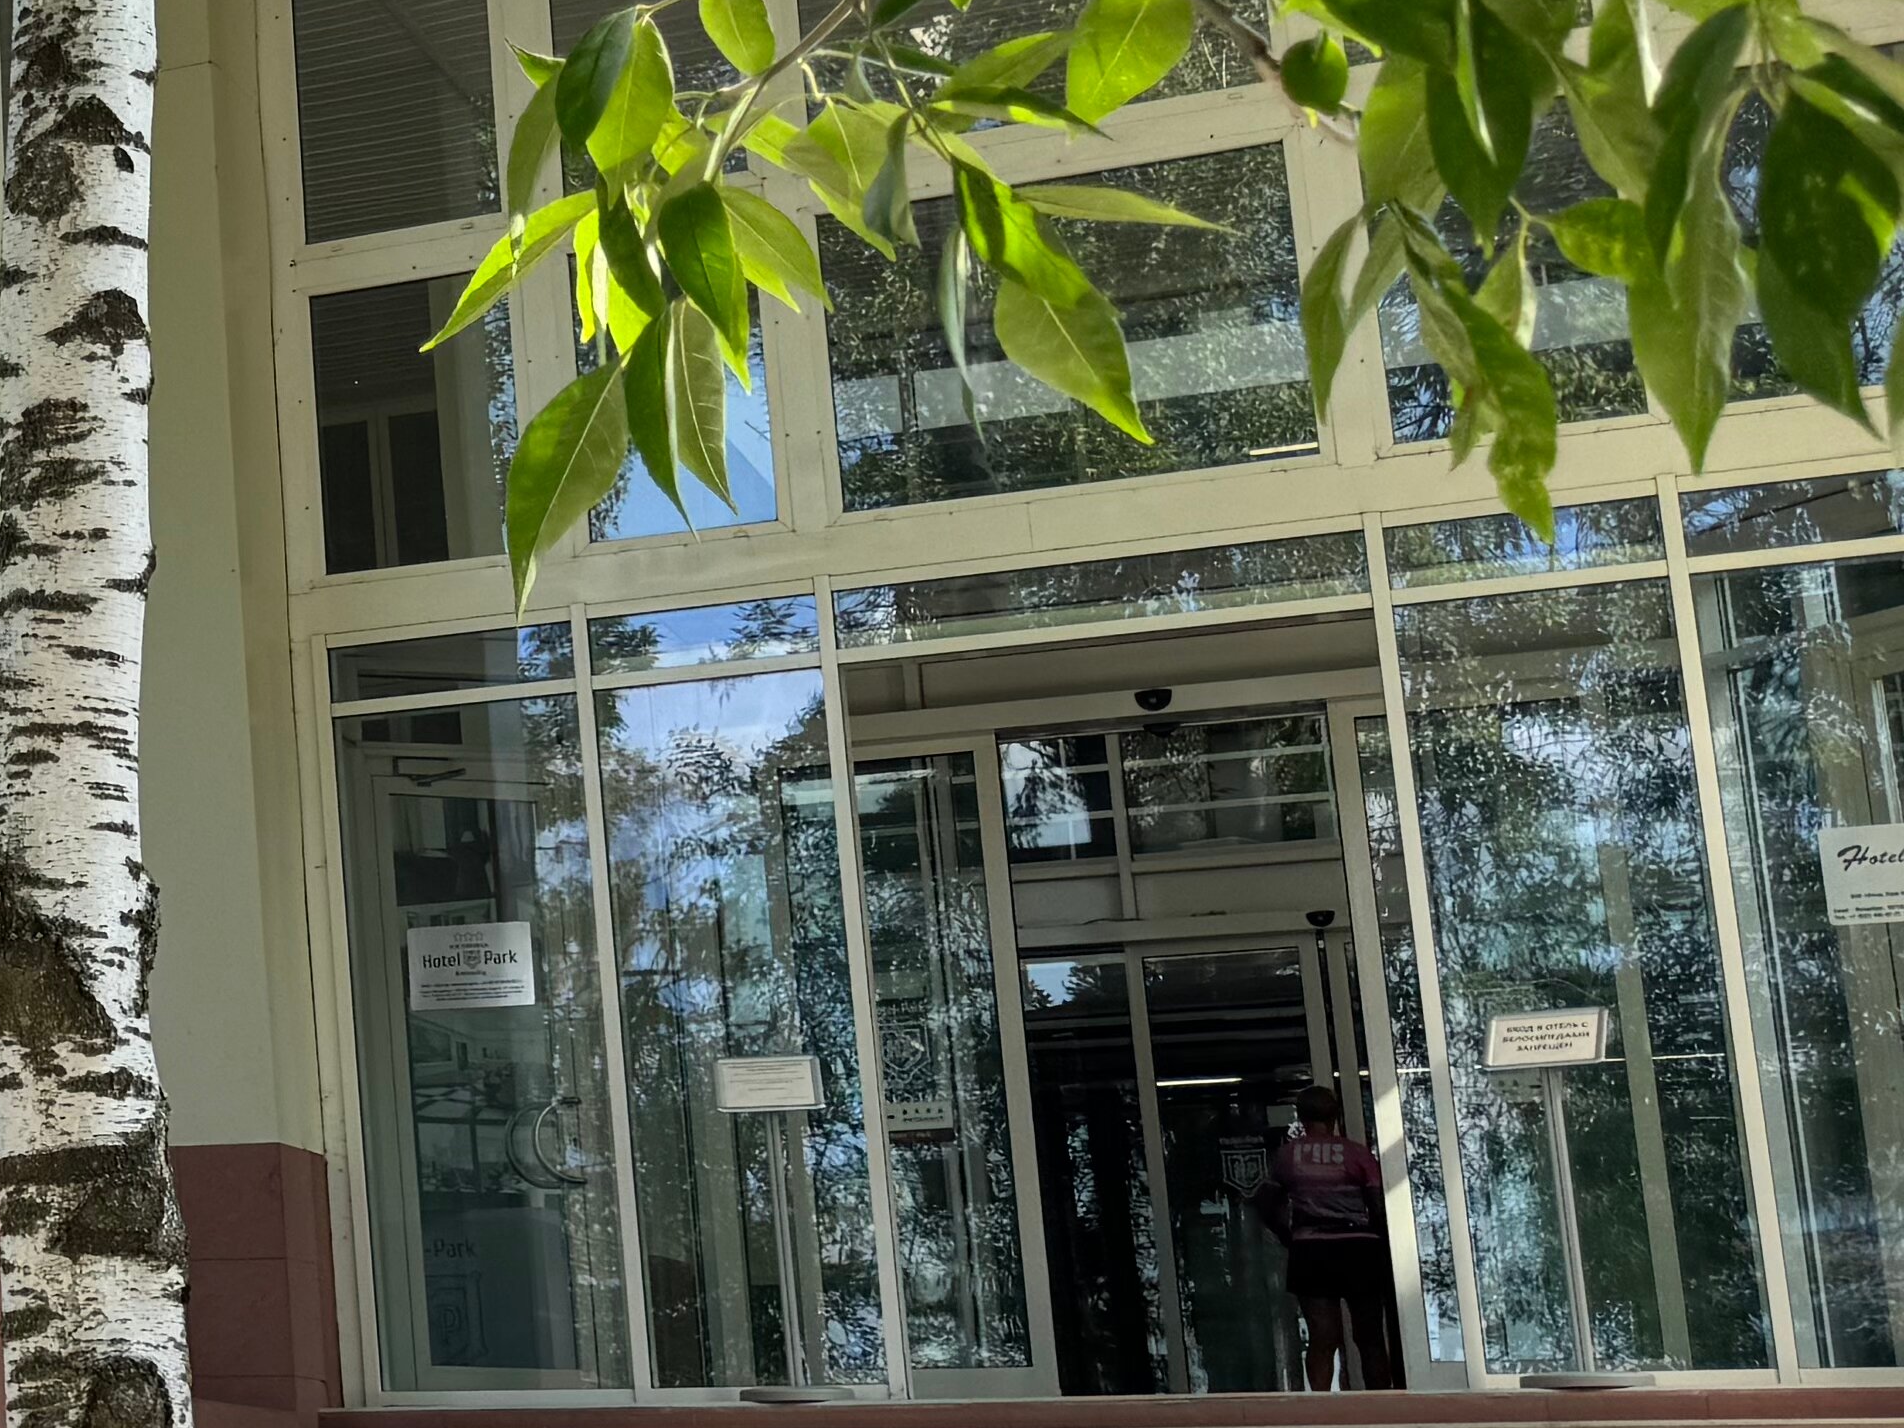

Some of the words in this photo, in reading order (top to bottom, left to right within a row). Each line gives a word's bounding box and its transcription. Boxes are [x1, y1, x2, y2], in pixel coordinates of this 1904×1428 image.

[1837, 845, 1904, 871] Hotel
[423, 952, 461, 968] Hotel
[484, 949, 518, 965] Park
